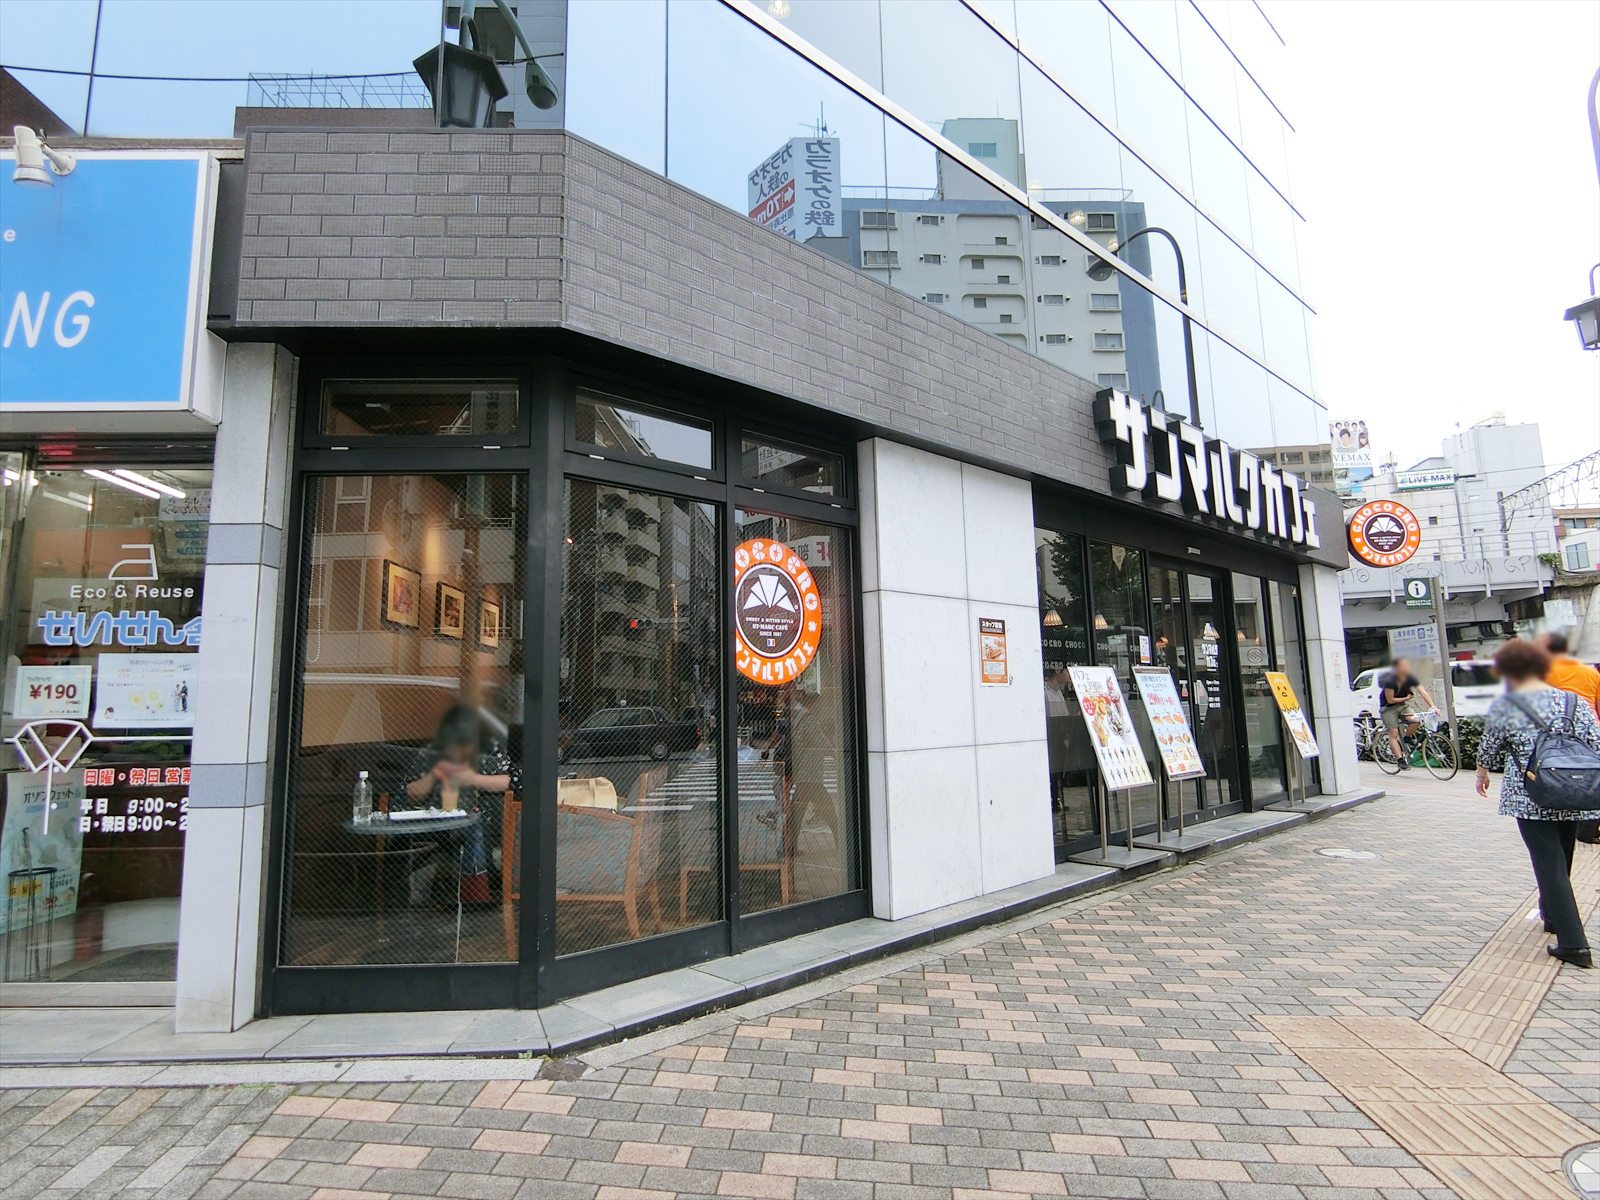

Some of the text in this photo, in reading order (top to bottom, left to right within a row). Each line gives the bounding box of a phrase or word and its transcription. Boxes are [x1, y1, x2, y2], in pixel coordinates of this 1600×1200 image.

[1108, 386, 1321, 550] サンマルクカフェ
[1430, 473, 1452, 482] MAX
[1352, 502, 1418, 533] CHOCO CRO
[1360, 544, 1416, 565] サンマルクカフェ
[70, 584, 195, 598] Eco & Reuse
[30, 684, 77, 699] ¥190
[84, 768, 161, 786] 日曜・祭日
[80, 798, 109, 815] 平日
